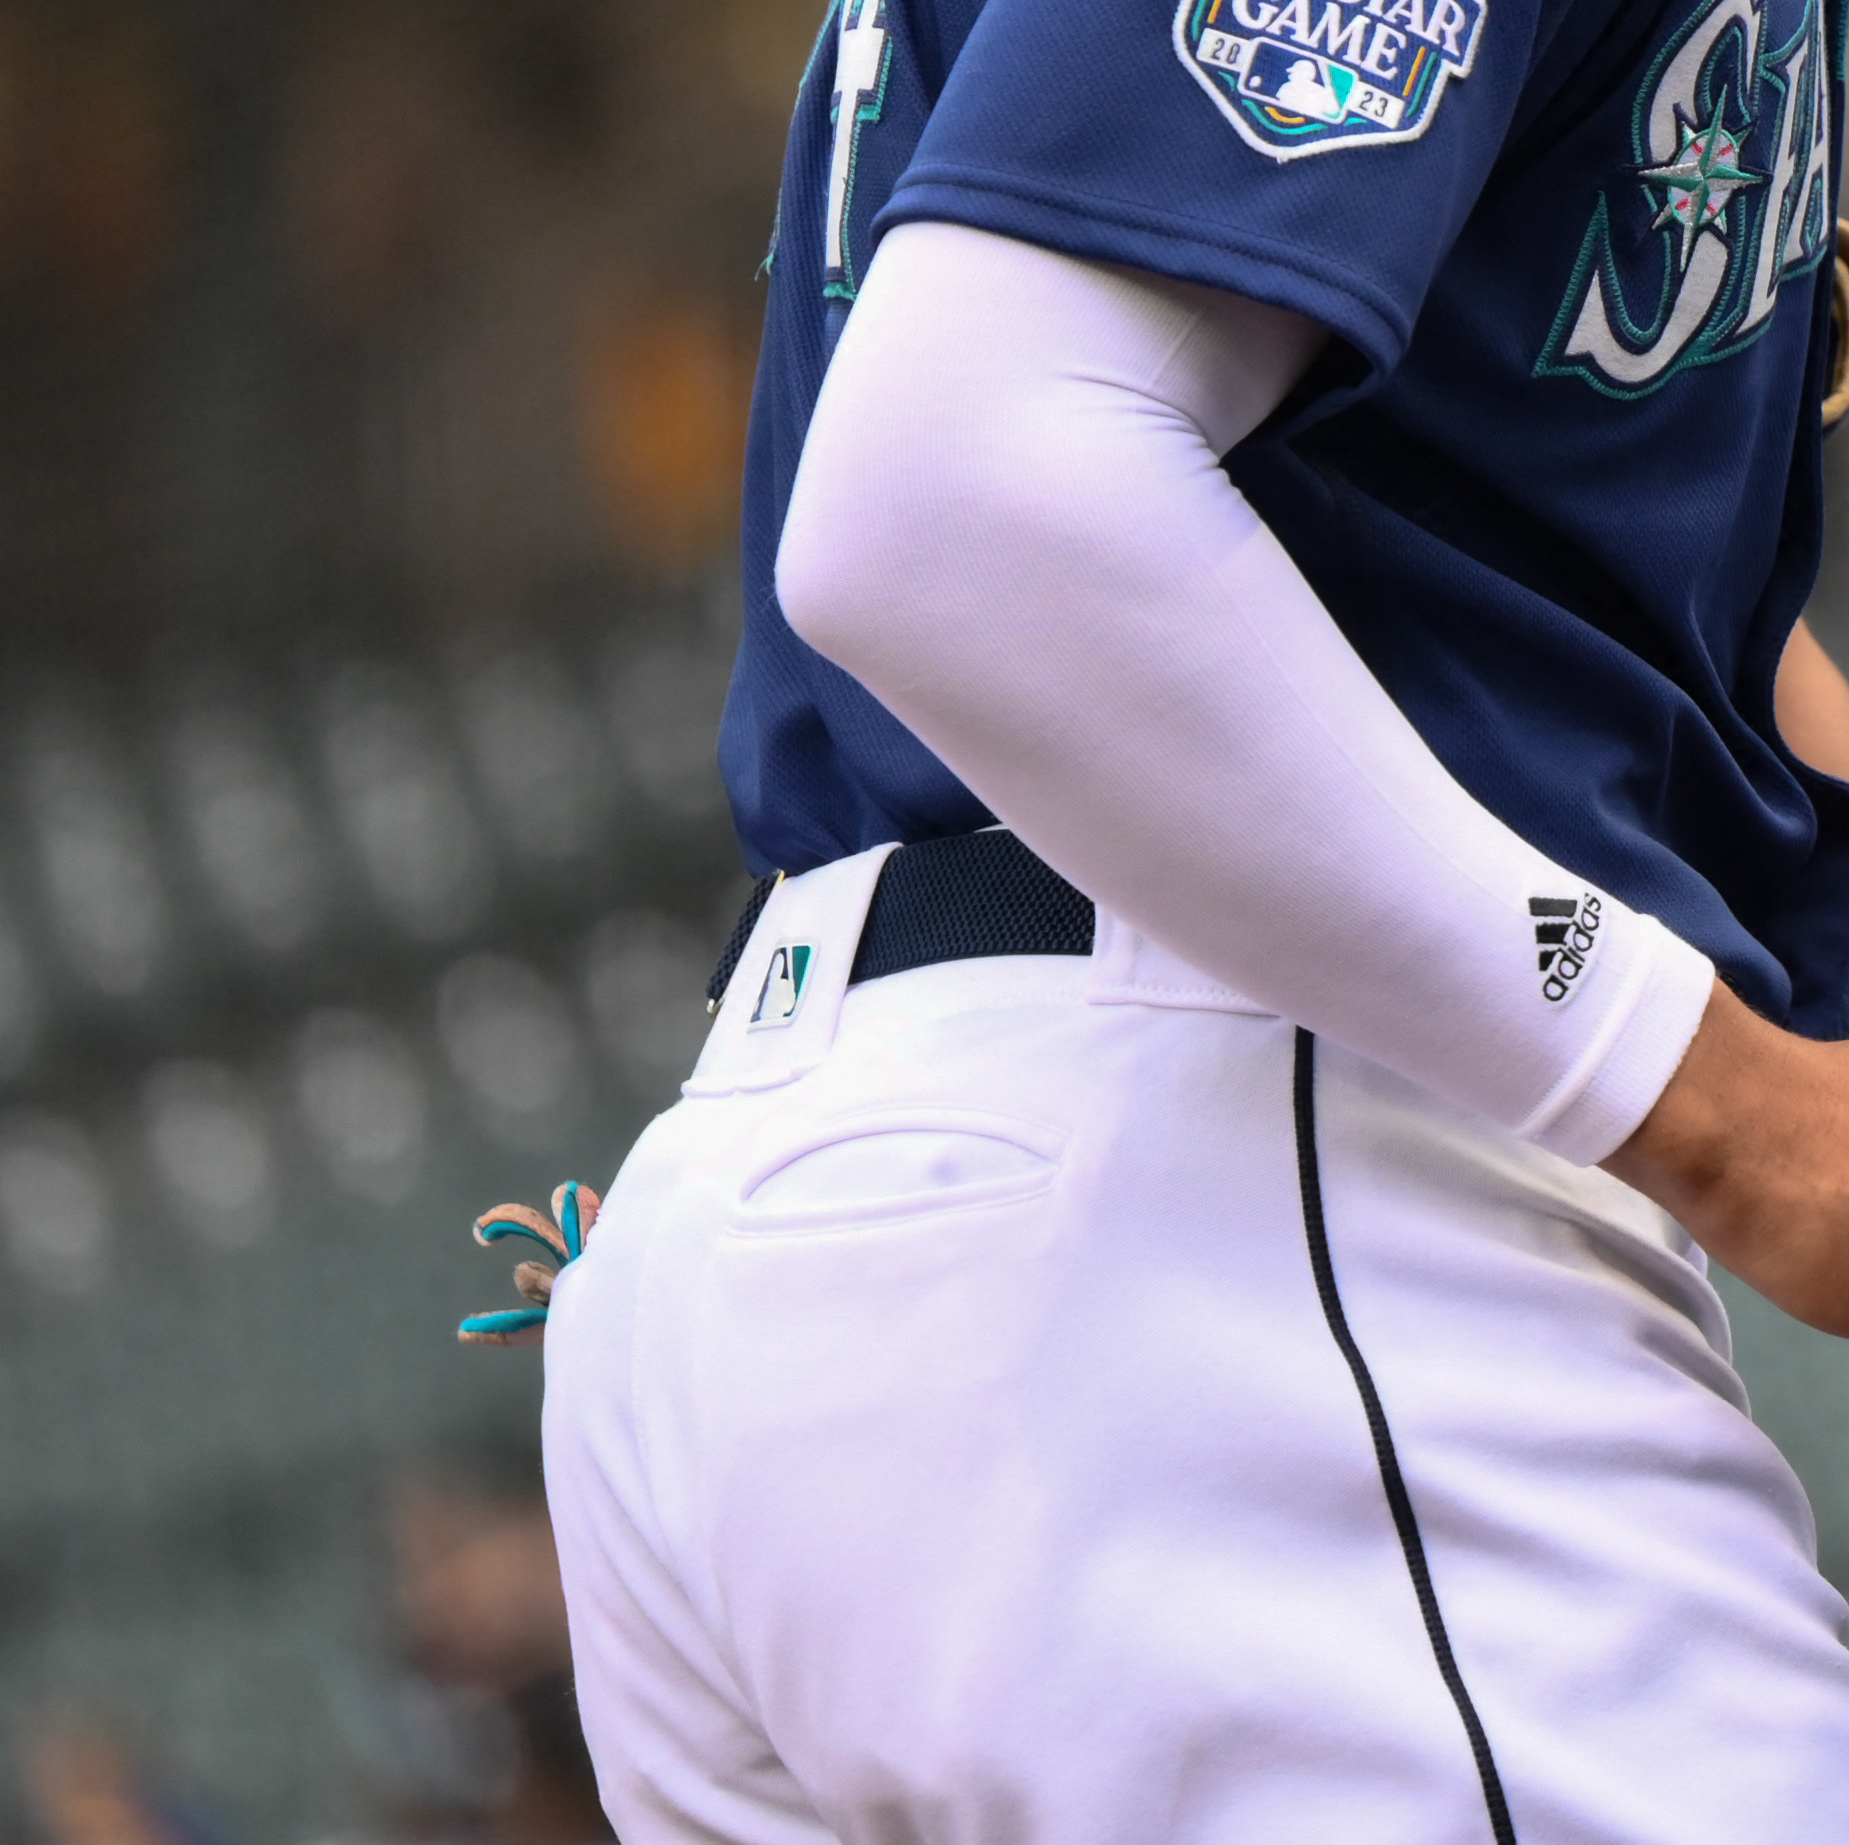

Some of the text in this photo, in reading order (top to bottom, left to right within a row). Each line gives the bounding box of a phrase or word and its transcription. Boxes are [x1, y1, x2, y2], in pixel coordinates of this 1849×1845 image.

[1213, 37, 1391, 118] 20 23
[1541, 891, 1602, 1002] adidas
